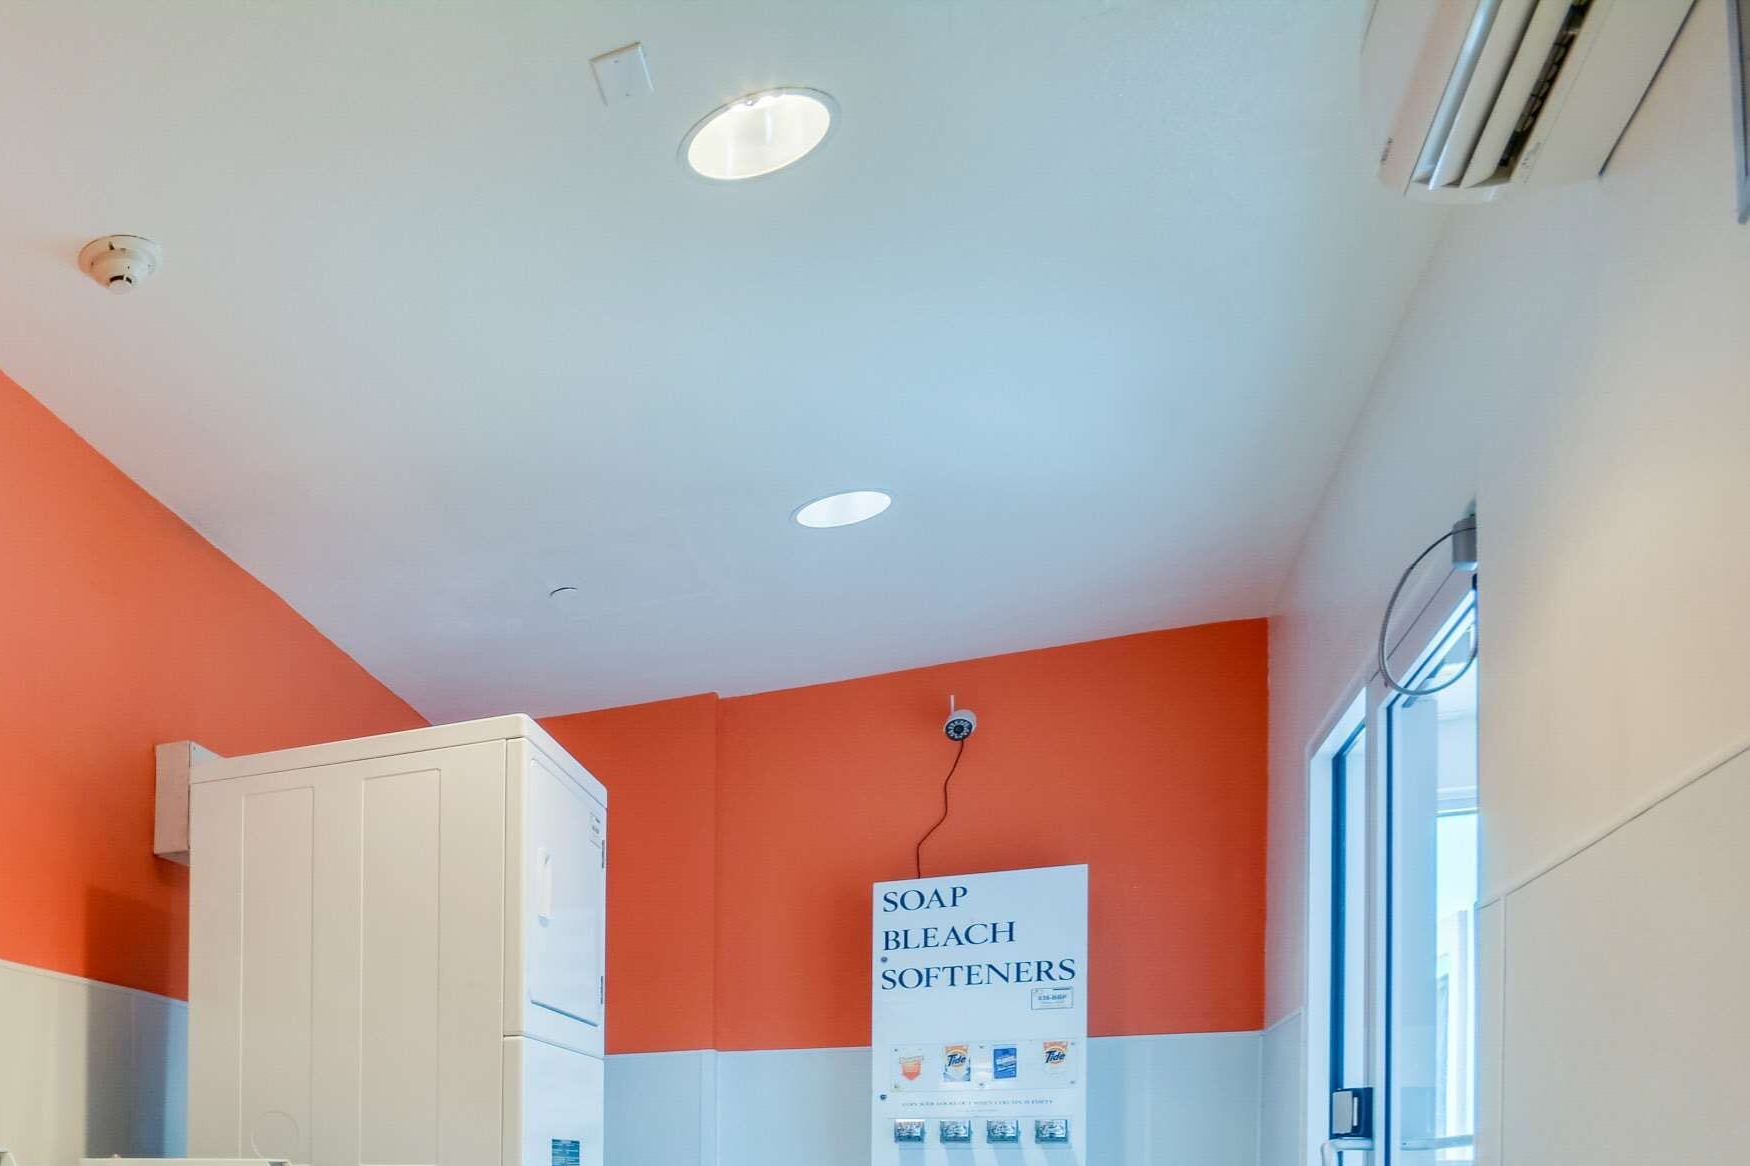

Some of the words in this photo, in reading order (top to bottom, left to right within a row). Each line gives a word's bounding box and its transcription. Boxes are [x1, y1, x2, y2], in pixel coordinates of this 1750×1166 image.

[882, 886, 968, 913] SOAP
[882, 921, 1017, 952] BLEACH
[881, 957, 1076, 991] SOFTENERS
[948, 1054, 967, 1067] Tide
[1045, 1050, 1066, 1064] Tide
